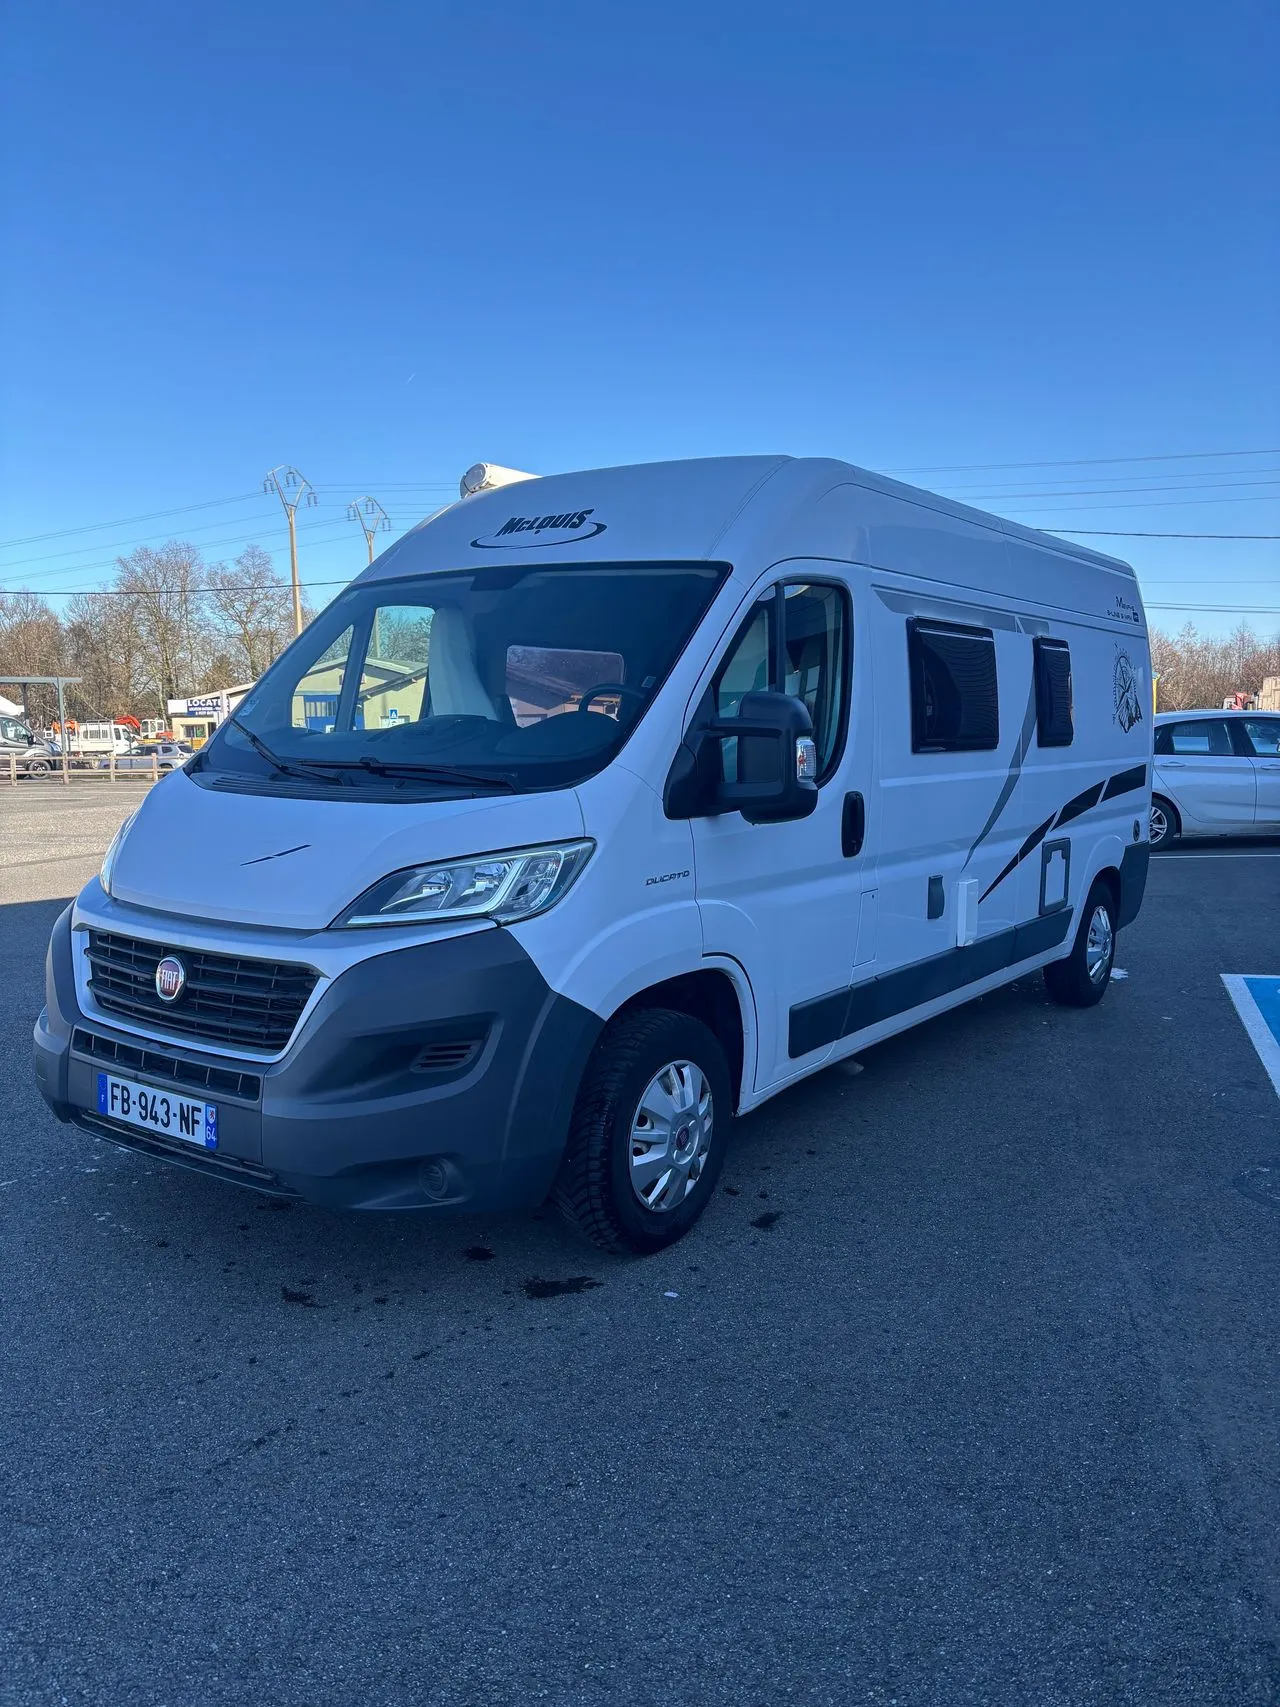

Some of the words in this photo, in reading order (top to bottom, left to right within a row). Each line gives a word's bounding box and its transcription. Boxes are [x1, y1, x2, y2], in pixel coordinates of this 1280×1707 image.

[645, 870, 690, 886] DUCATO
[160, 969, 179, 991] FIAT
[110, 1082, 202, 1136] FB-943-NF
[206, 1126, 216, 1142] 64
